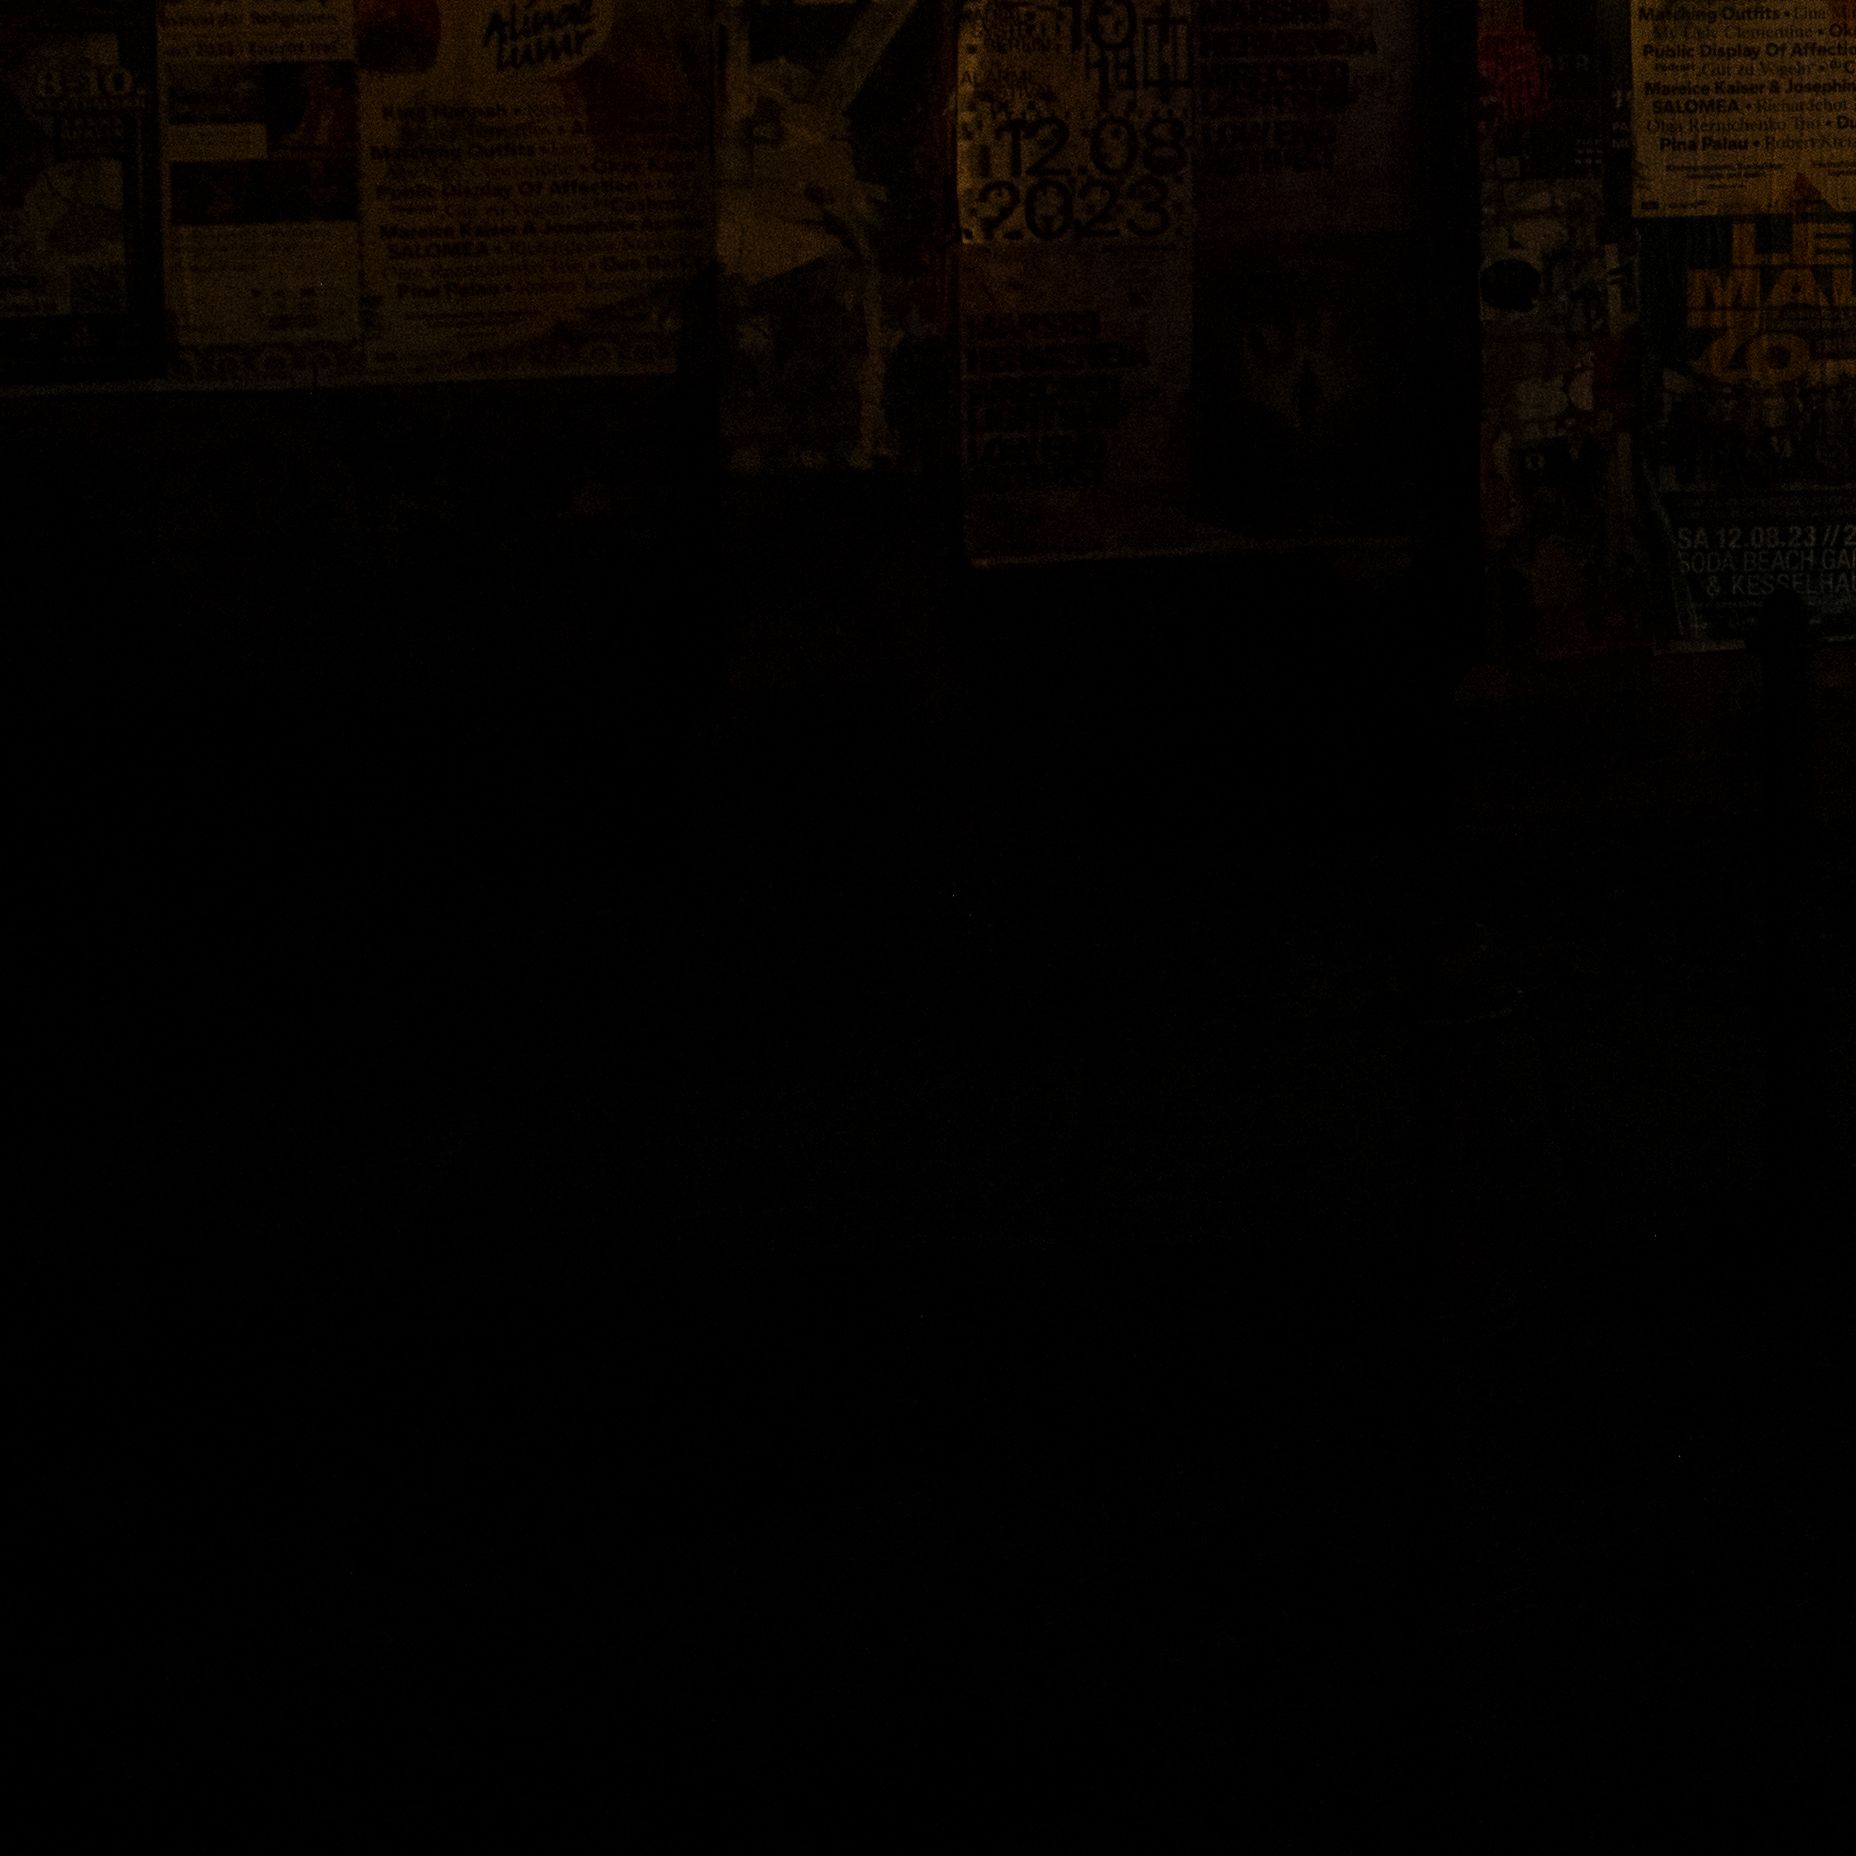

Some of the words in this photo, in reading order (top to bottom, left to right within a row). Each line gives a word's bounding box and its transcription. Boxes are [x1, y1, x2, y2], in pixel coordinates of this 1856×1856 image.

[1642, 43, 1696, 59] Public
[1699, 42, 1761, 61] Display
[1713, 79, 1765, 95] Kaiser
[1651, 98, 1740, 115] SALOMEA
[1659, 137, 1698, 152] Pina
[1700, 137, 1749, 152] Palau
[1731, 221, 1855, 267] LE
[1676, 528, 1711, 550] SA
[1715, 524, 1817, 550] 12.08.23
[1676, 550, 1738, 575] SODA
[1741, 547, 1816, 574] BEACH
